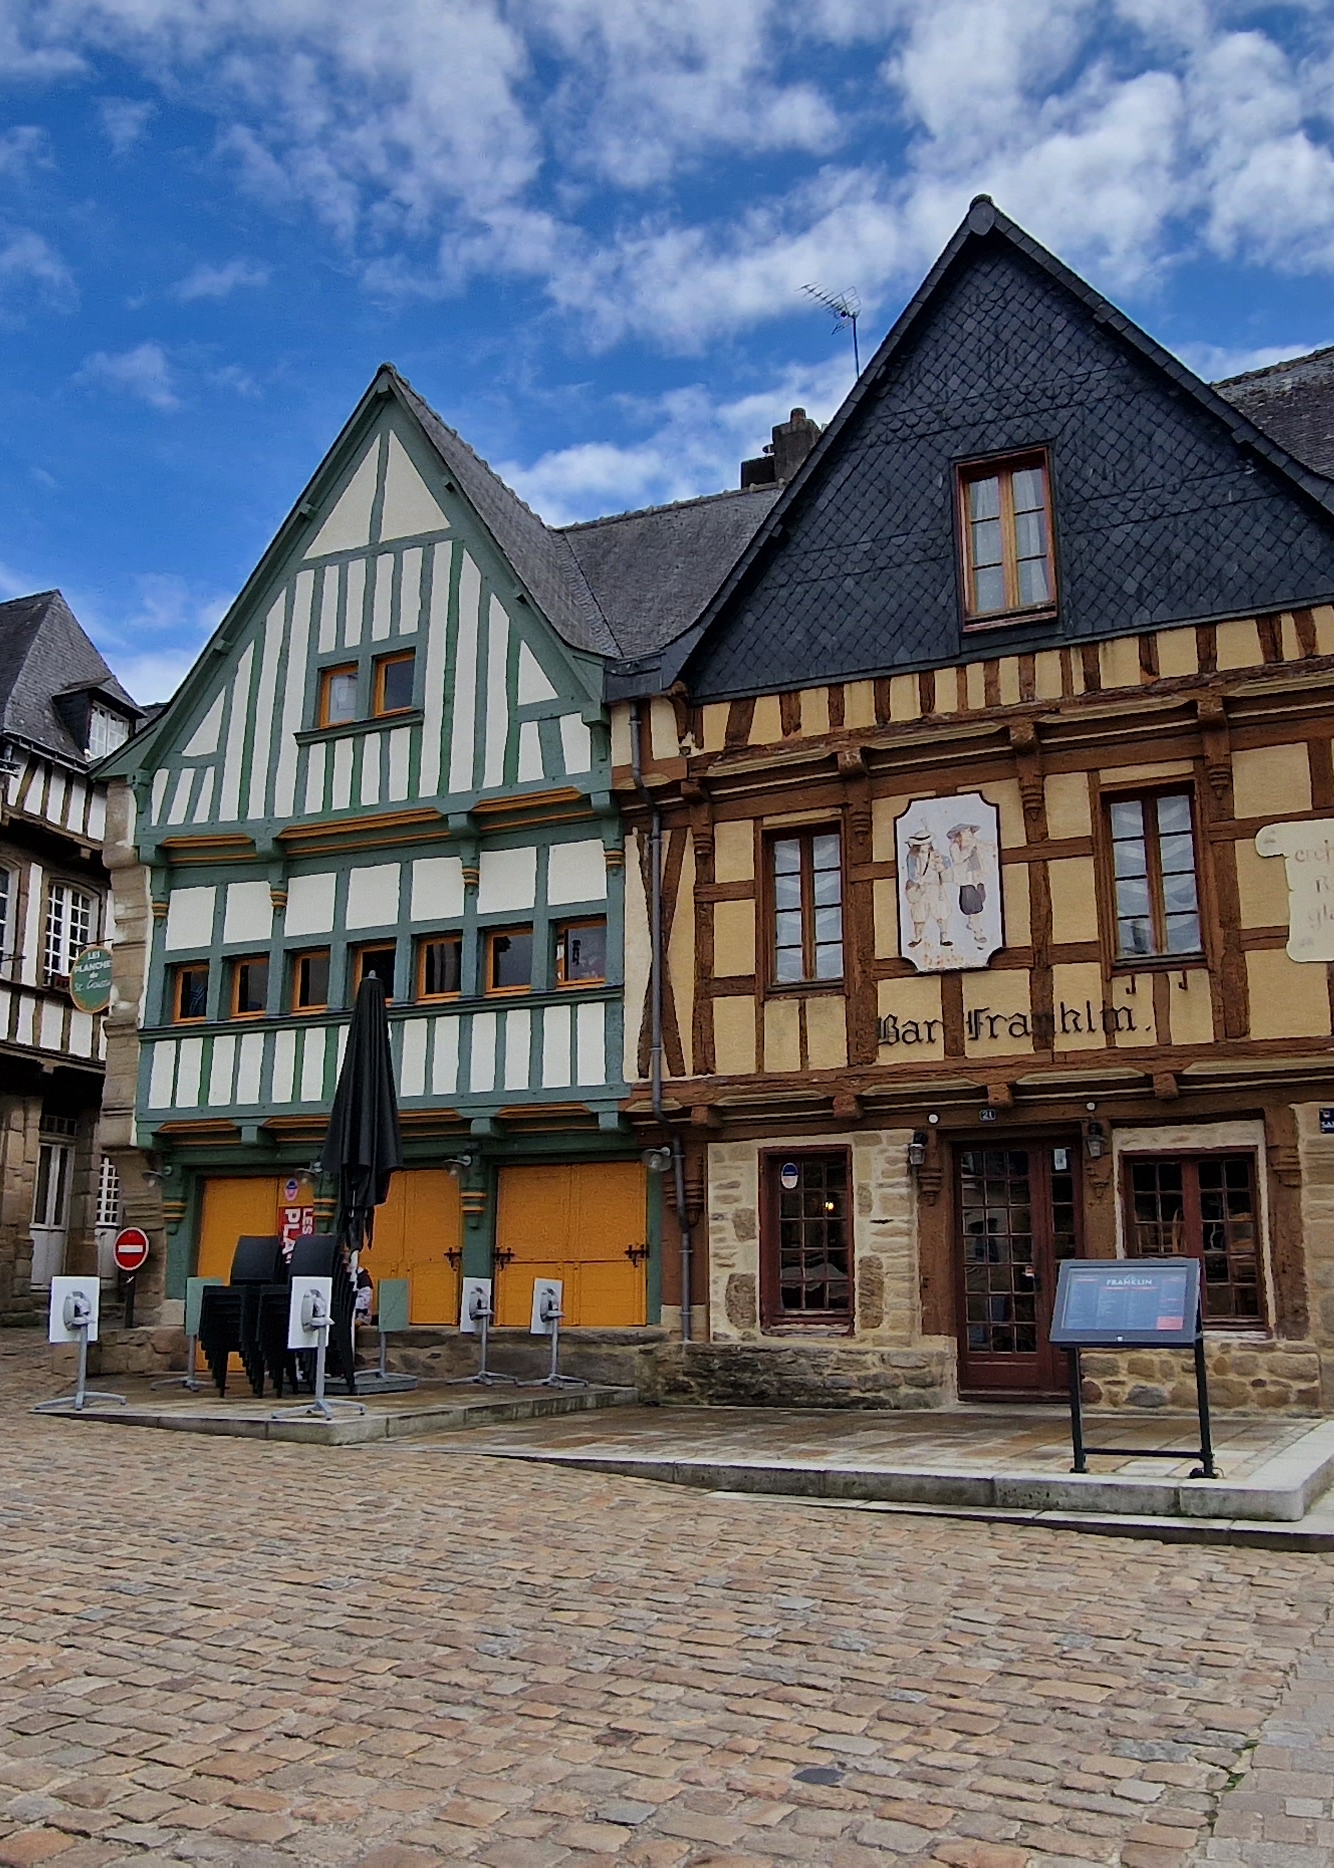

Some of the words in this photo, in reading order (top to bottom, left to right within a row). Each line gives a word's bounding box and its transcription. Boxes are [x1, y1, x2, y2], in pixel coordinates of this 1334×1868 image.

[87, 951, 101, 961] LES
[73, 960, 113, 974] PLANCHE
[877, 1013, 944, 1046] Bar
[301, 1207, 314, 1235] LES
[1106, 1278, 1153, 1286] FRANKLIN
